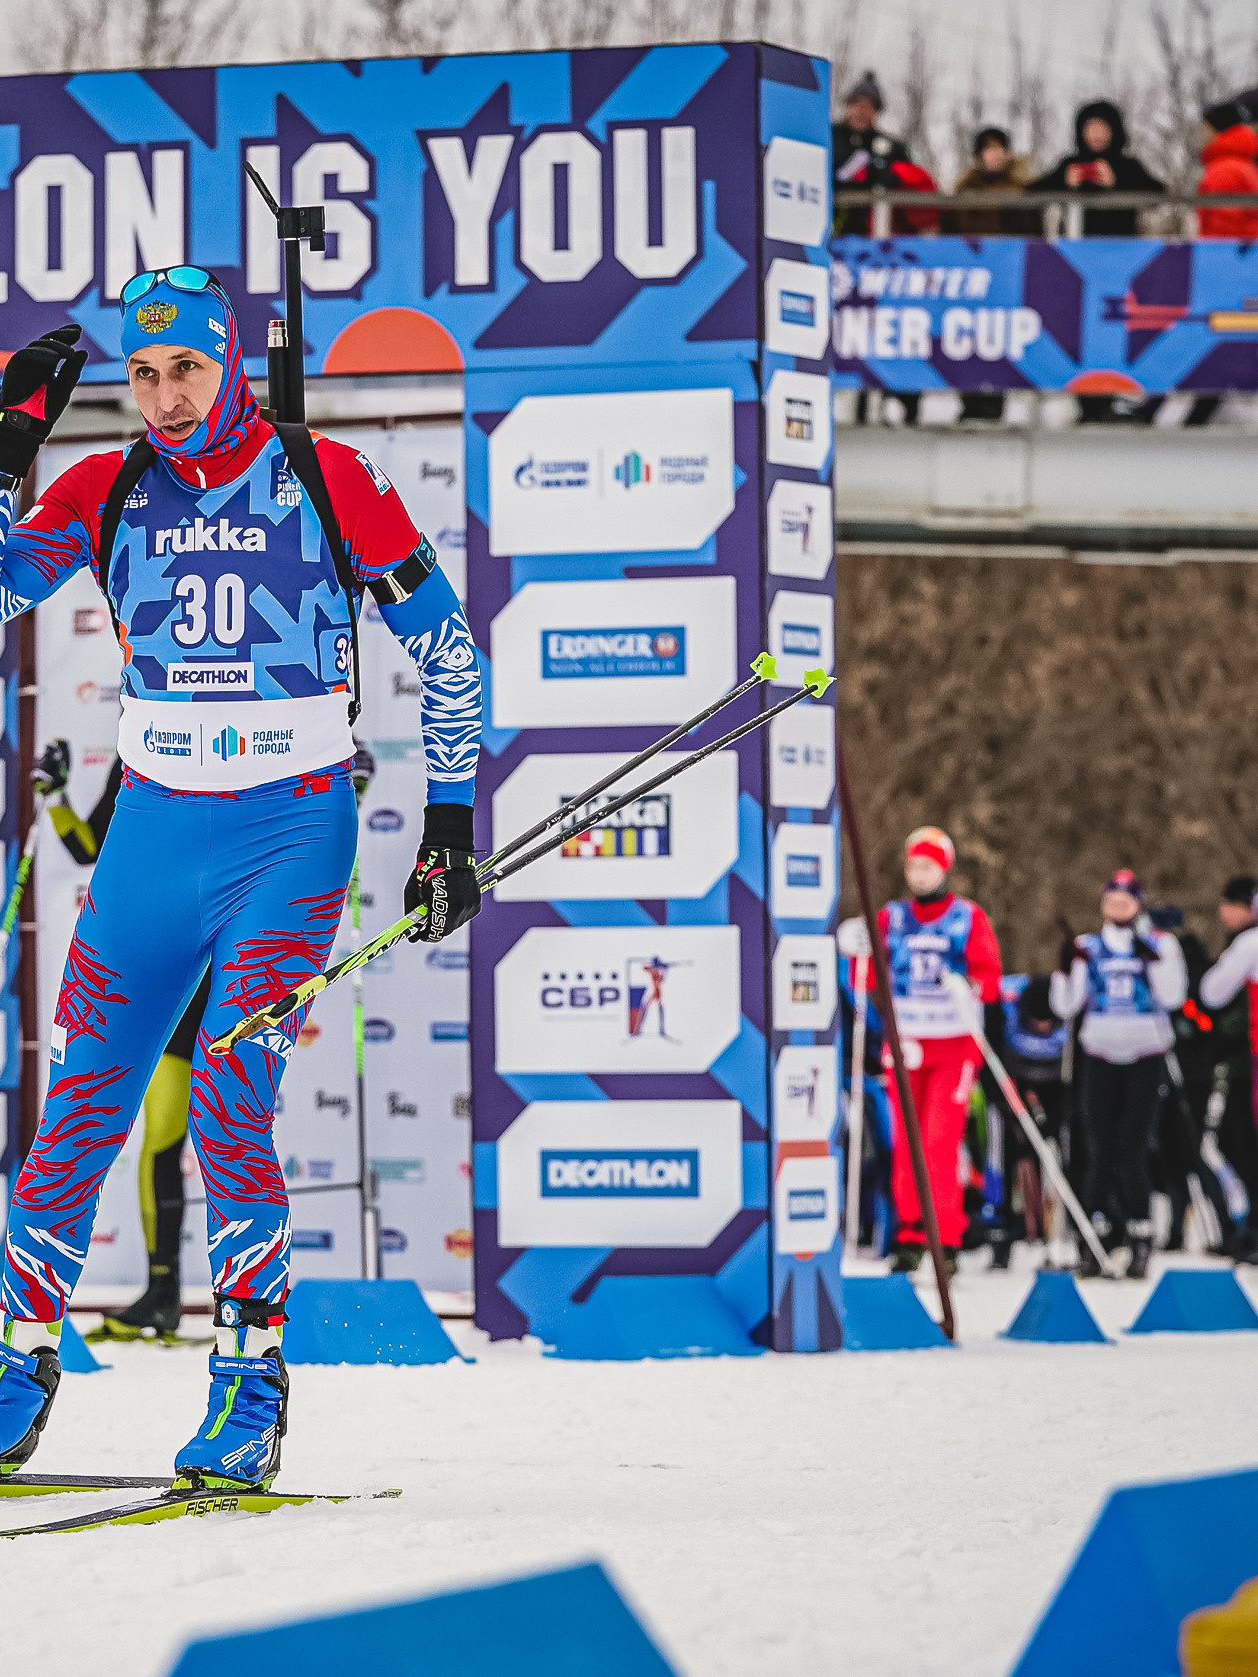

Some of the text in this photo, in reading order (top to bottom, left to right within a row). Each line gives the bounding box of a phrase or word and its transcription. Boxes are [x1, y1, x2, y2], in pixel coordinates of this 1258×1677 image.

[245, 141, 374, 295] IS
[426, 125, 698, 287] YOU
[857, 267, 992, 299] WINTER
[941, 306, 1042, 362] CUP
[276, 491, 302, 507] CUP
[155, 517, 267, 554] rukka
[174, 573, 245, 645] 30
[172, 669, 248, 685] DECATHLON
[155, 730, 192, 746] ГАЗПРОМ
[252, 728, 294, 743] РОДНЫЕ
[253, 742, 291, 756] ГОРОДА
[542, 987, 620, 1009] СБР
[547, 1159, 691, 1189] DECATHLON
[214, 1361, 268, 1370] SPINE
[221, 1423, 276, 1471] SPINE
[185, 1497, 239, 1518] FISCHER
